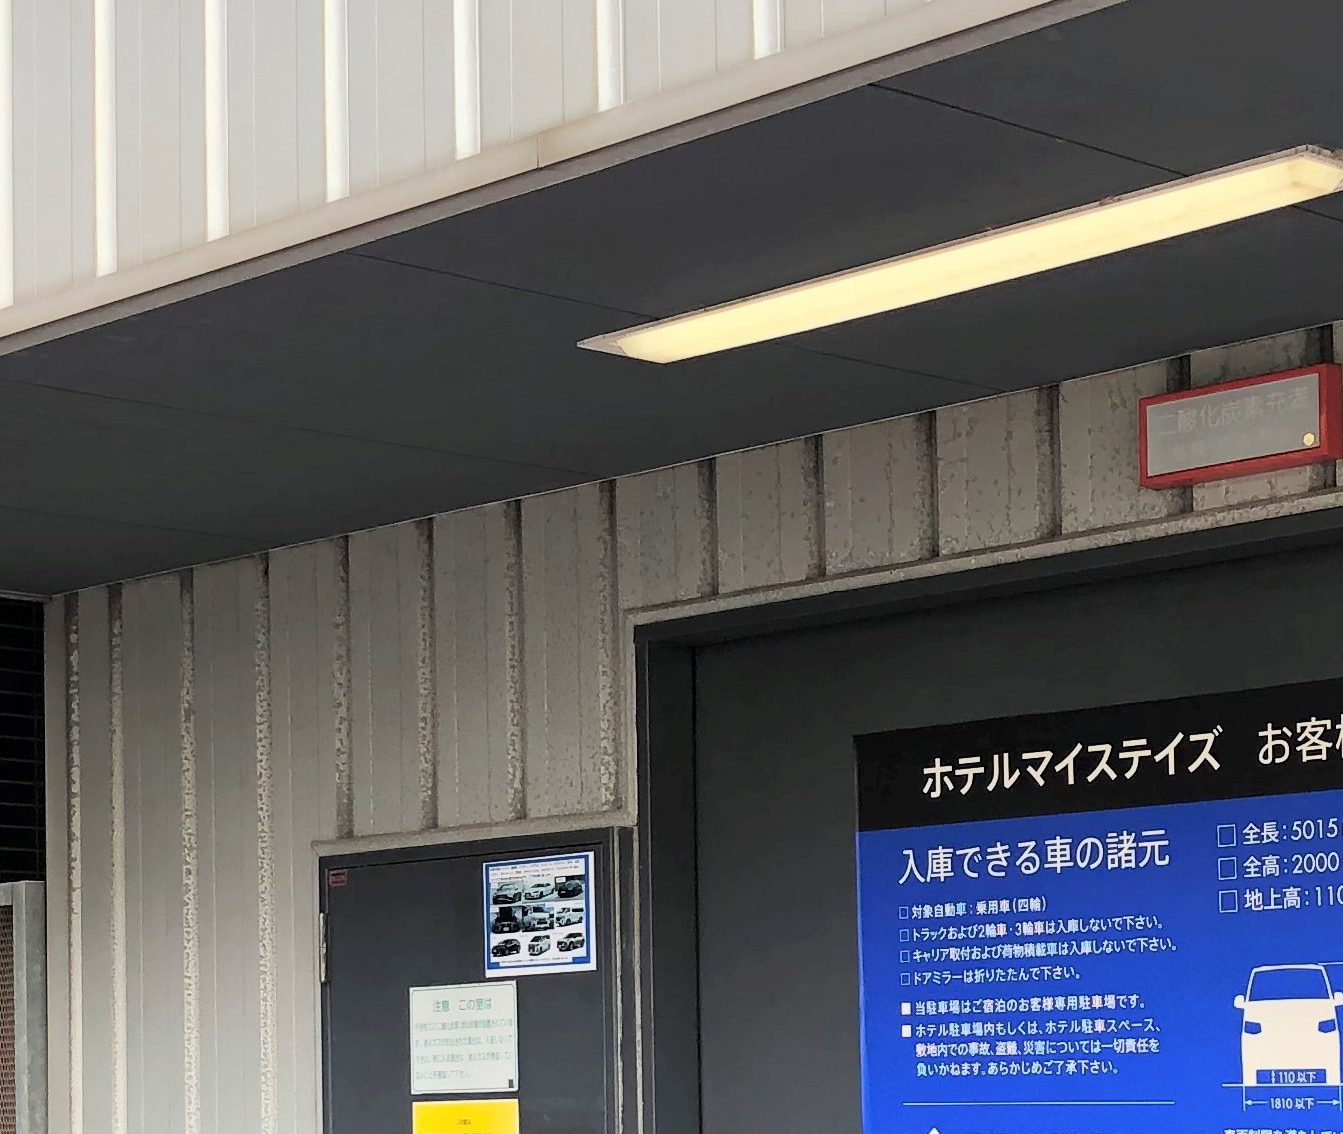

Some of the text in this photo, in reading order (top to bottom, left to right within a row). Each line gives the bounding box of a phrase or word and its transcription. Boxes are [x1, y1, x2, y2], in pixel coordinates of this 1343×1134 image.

[921, 724, 1224, 798] ホテルマイステイズ
[898, 829, 1170, 885] 入庫できる車の諸元
[913, 966, 1081, 985] ドアミラーは折りたたんで下さい。
[915, 994, 1145, 1016] 当駐車場はご宿泊のお客様専用駐車場です。
[915, 1018, 1161, 1037] ホテル駐車場内もしくは、ホテル駐車スペース、
[917, 1060, 1119, 1077] 負いかねます。あらかじめご了承下さい。
